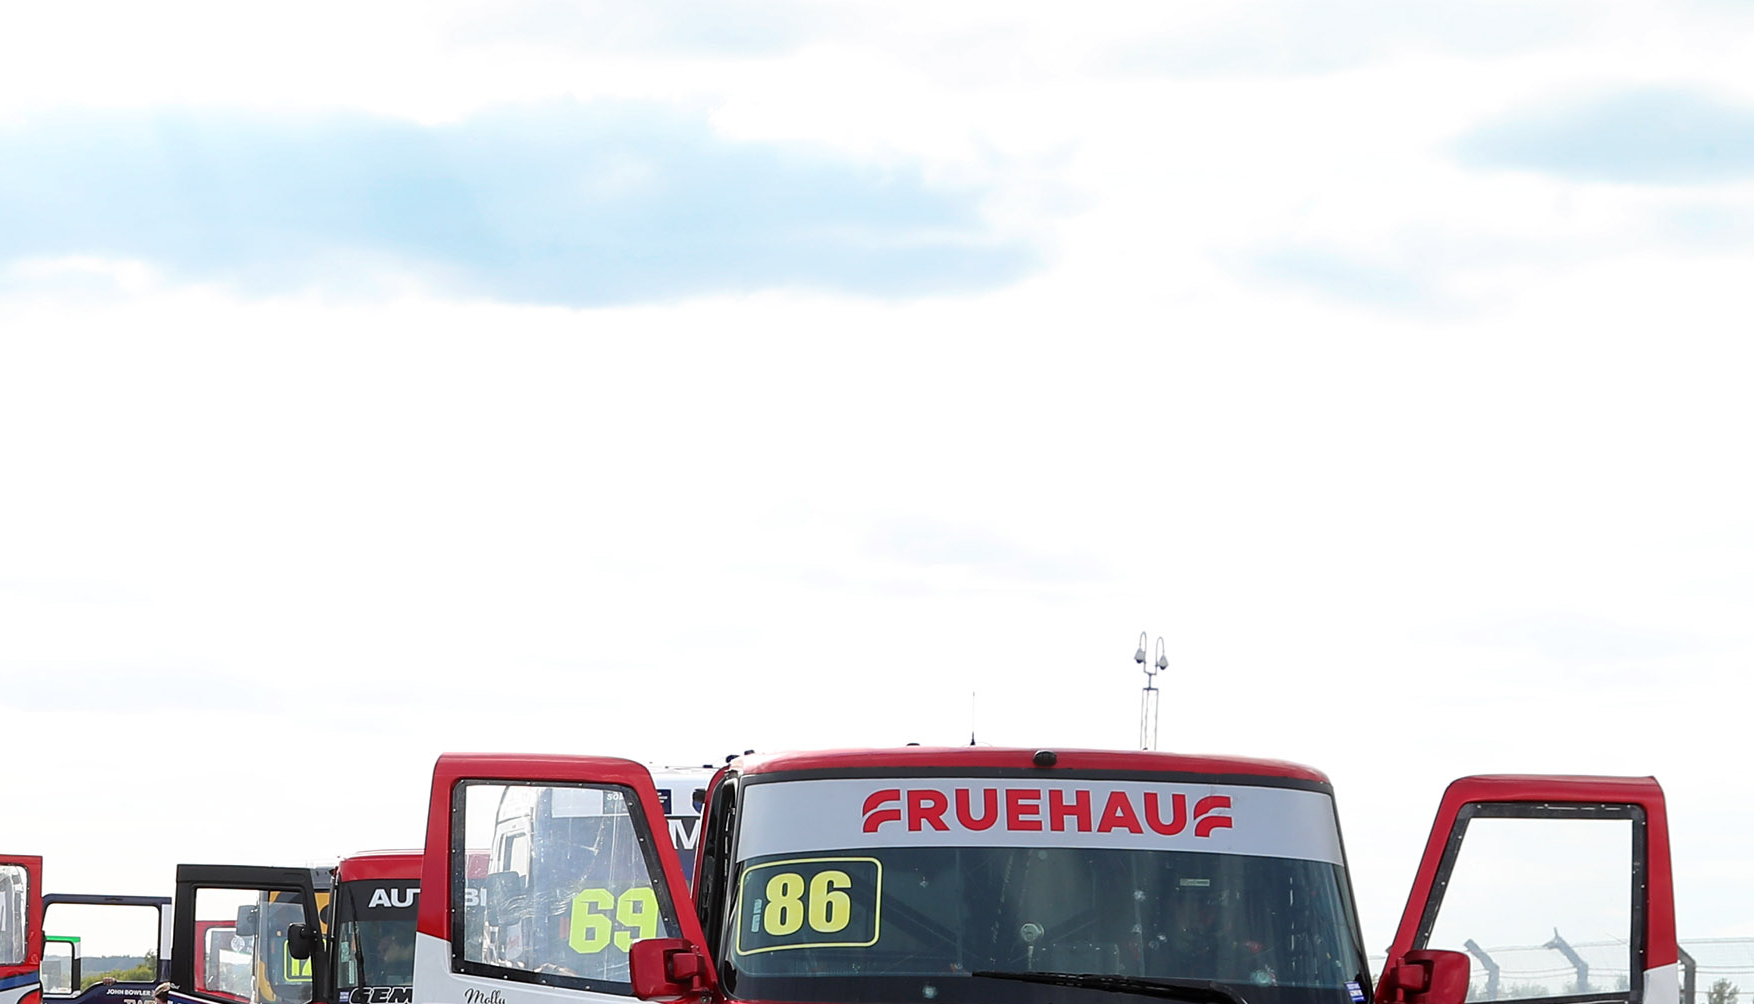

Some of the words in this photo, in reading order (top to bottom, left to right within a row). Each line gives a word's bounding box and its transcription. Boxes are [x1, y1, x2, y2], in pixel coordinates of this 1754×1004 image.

[862, 787, 1233, 838] FRUEHAUF
[569, 887, 658, 954] 69
[763, 870, 852, 936] 86
